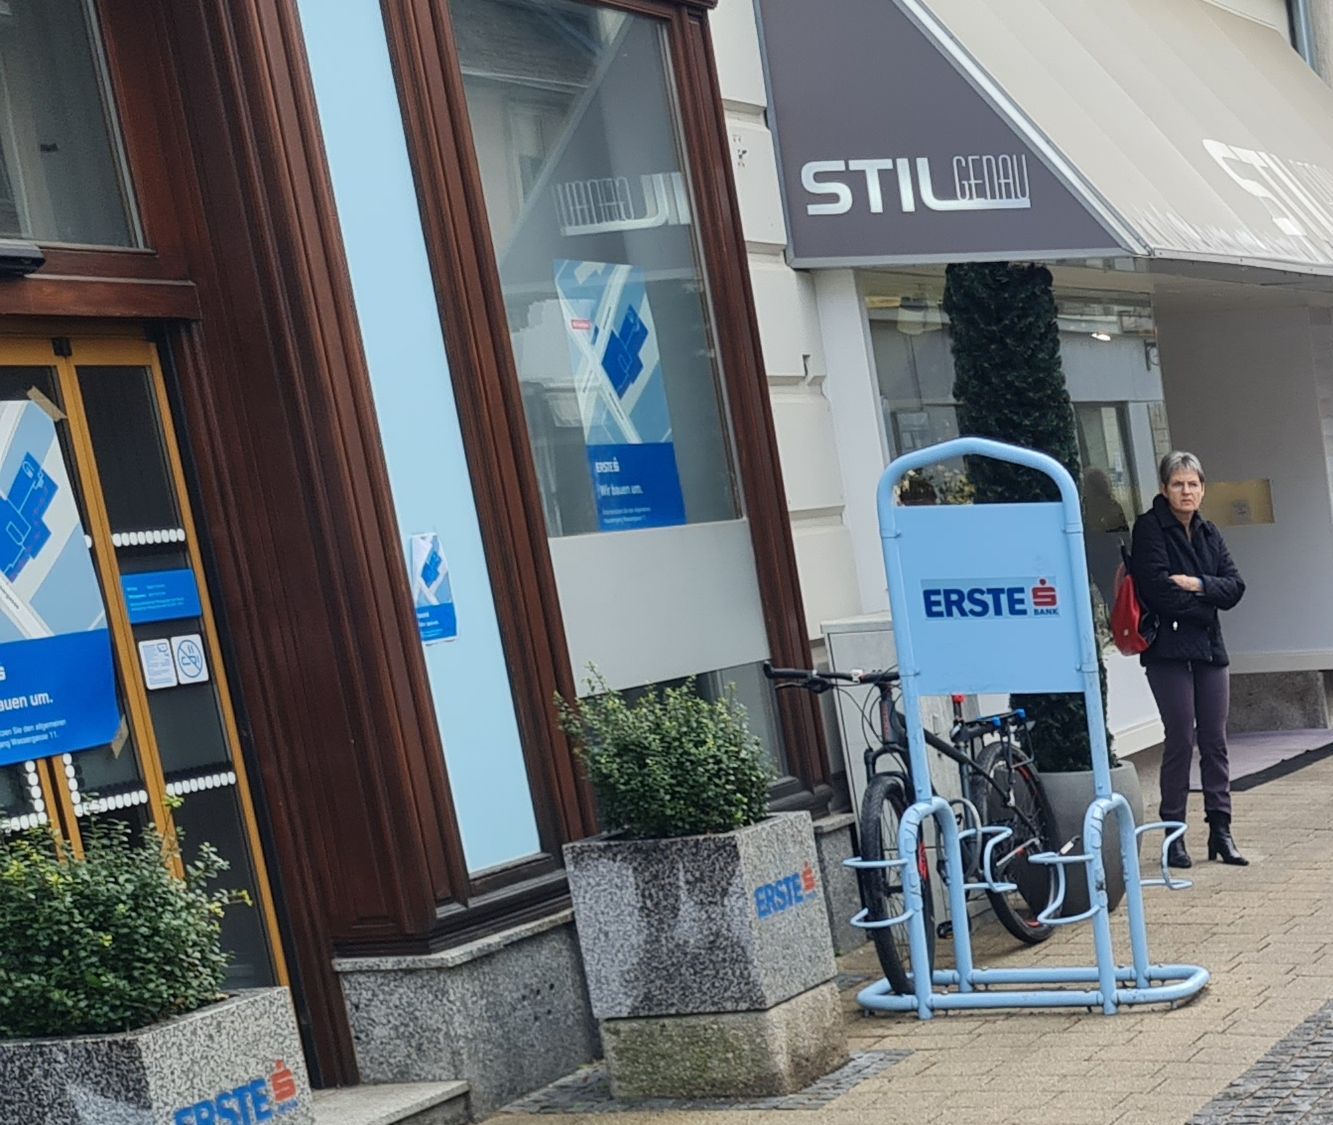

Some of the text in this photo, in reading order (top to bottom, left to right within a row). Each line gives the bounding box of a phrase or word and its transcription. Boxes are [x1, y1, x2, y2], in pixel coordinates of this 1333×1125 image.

[801, 154, 1031, 215] STIL GENAU
[923, 587, 1028, 618] ERSTE
[1034, 608, 1058, 616] BANK
[0, 692, 54, 712] auen um.
[755, 873, 804, 919] ERSTE
